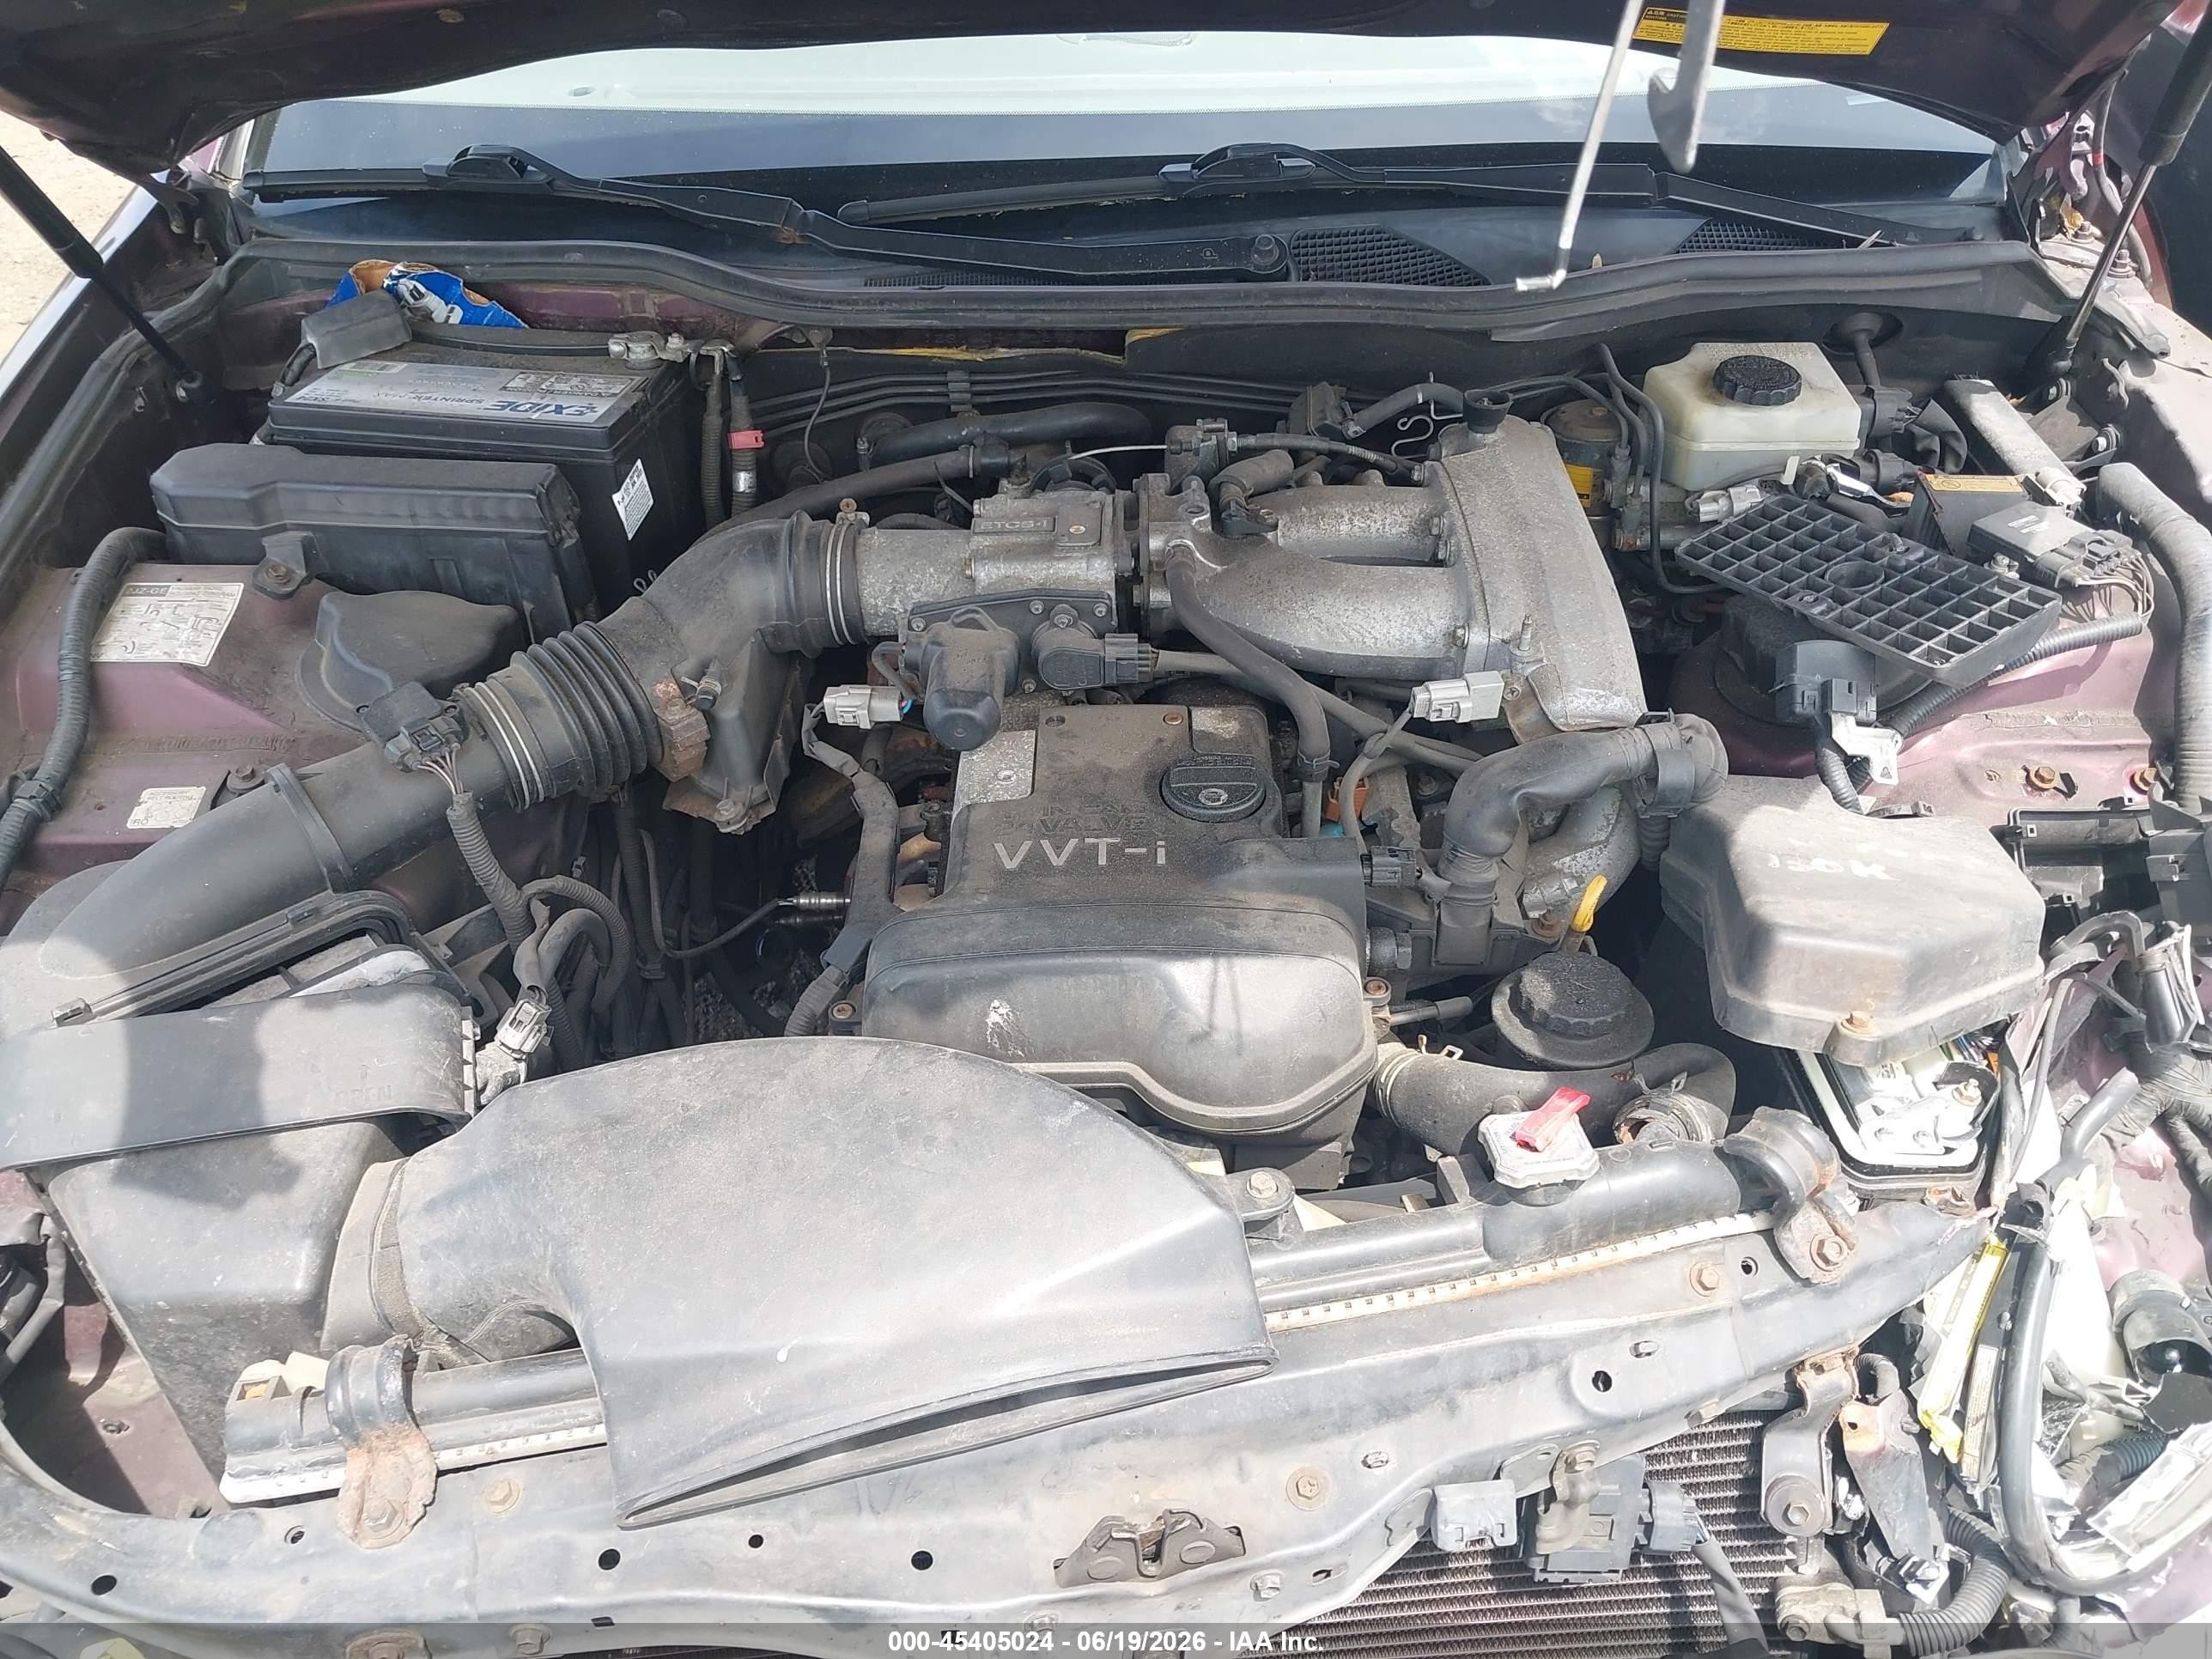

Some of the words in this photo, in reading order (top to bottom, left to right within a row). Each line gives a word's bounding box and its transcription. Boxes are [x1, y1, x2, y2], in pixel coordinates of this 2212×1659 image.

[412, 393, 485, 404] SPRINTER
[483, 400, 598, 418] EXIDE
[994, 837, 1166, 869] VVT-i
